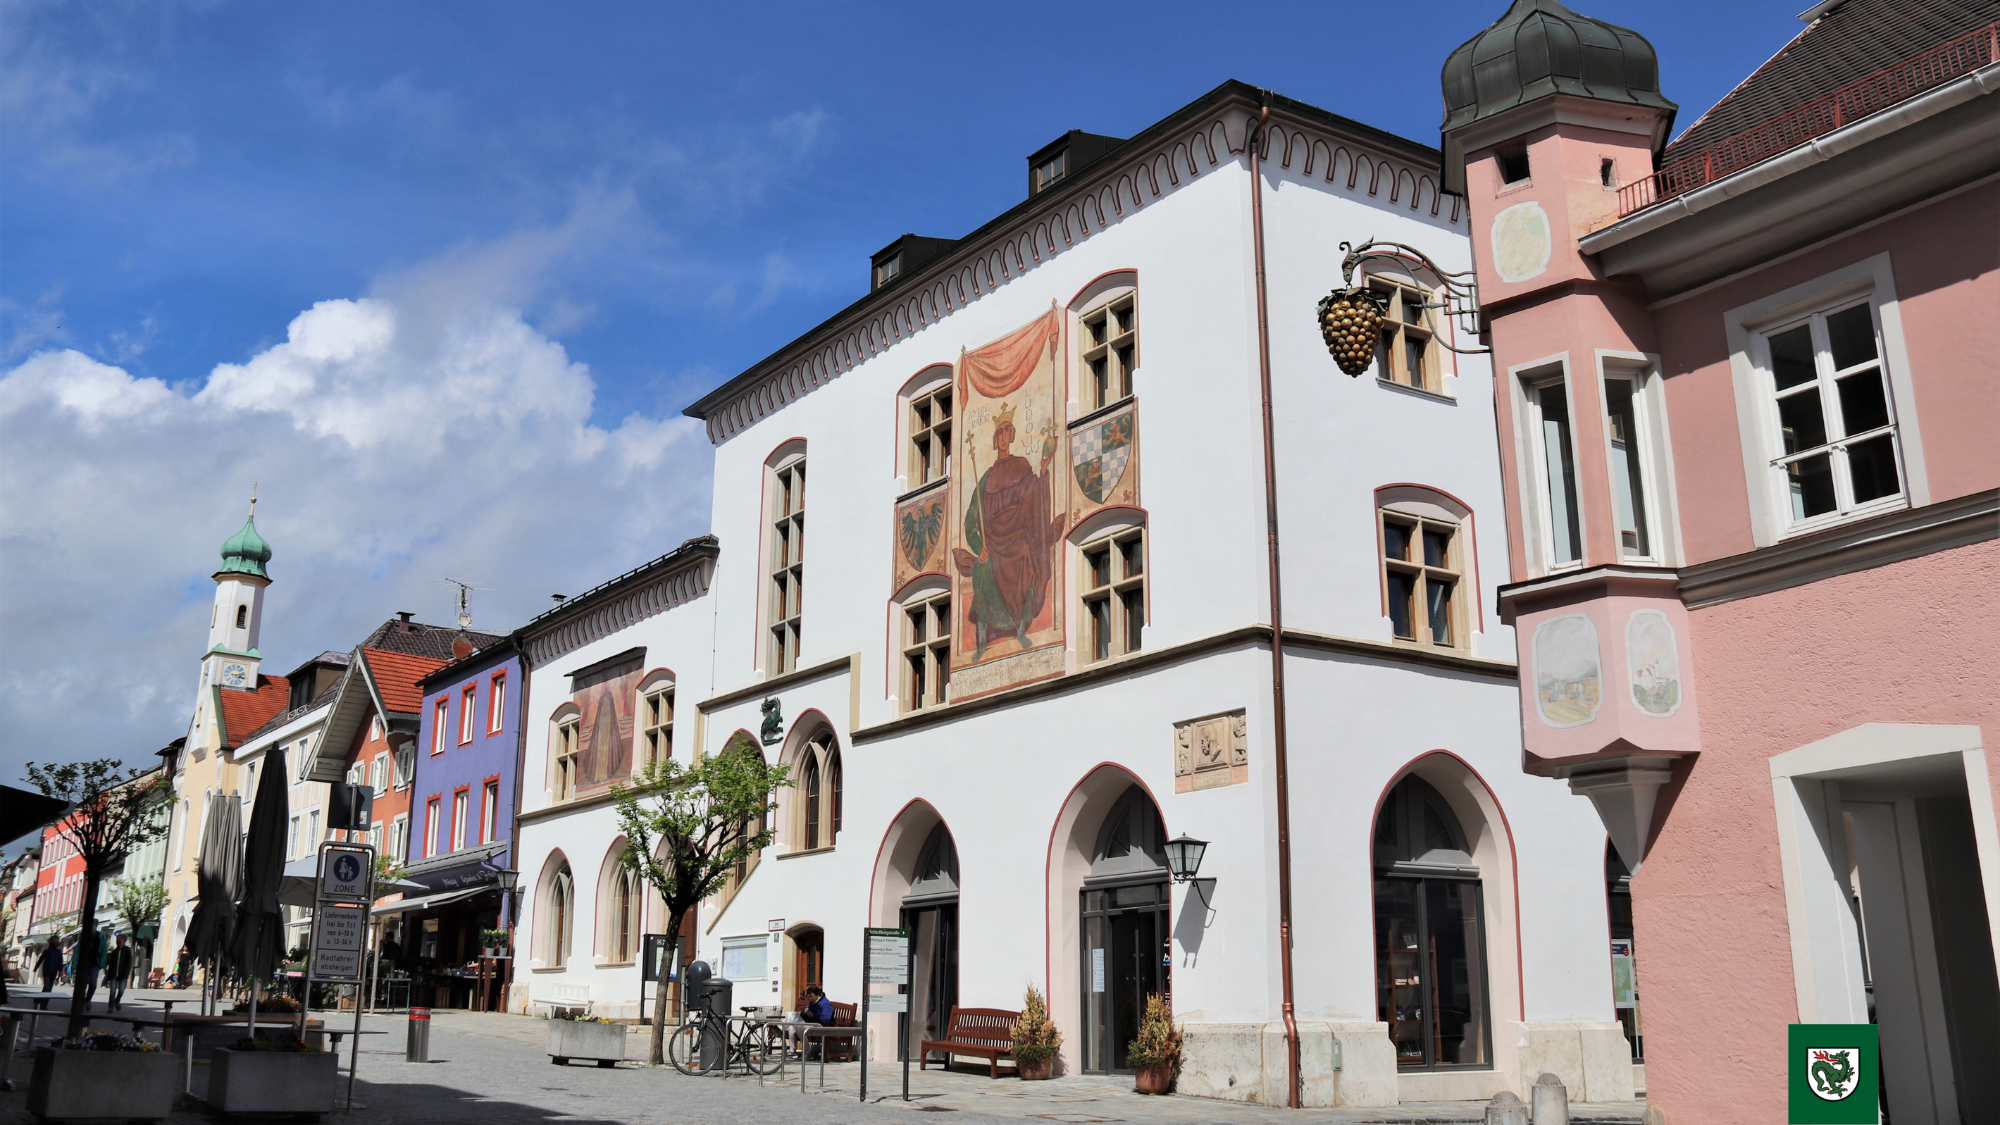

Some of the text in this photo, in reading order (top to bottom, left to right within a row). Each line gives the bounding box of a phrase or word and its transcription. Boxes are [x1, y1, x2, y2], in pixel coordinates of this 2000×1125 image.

[333, 884, 356, 894] ZONE
[325, 911, 359, 920] Lieferverkehr
[326, 920, 336, 928] frei
[337, 920, 345, 928] bis
[320, 953, 355, 963] Radfahrer
[320, 963, 354, 972] absteigen
